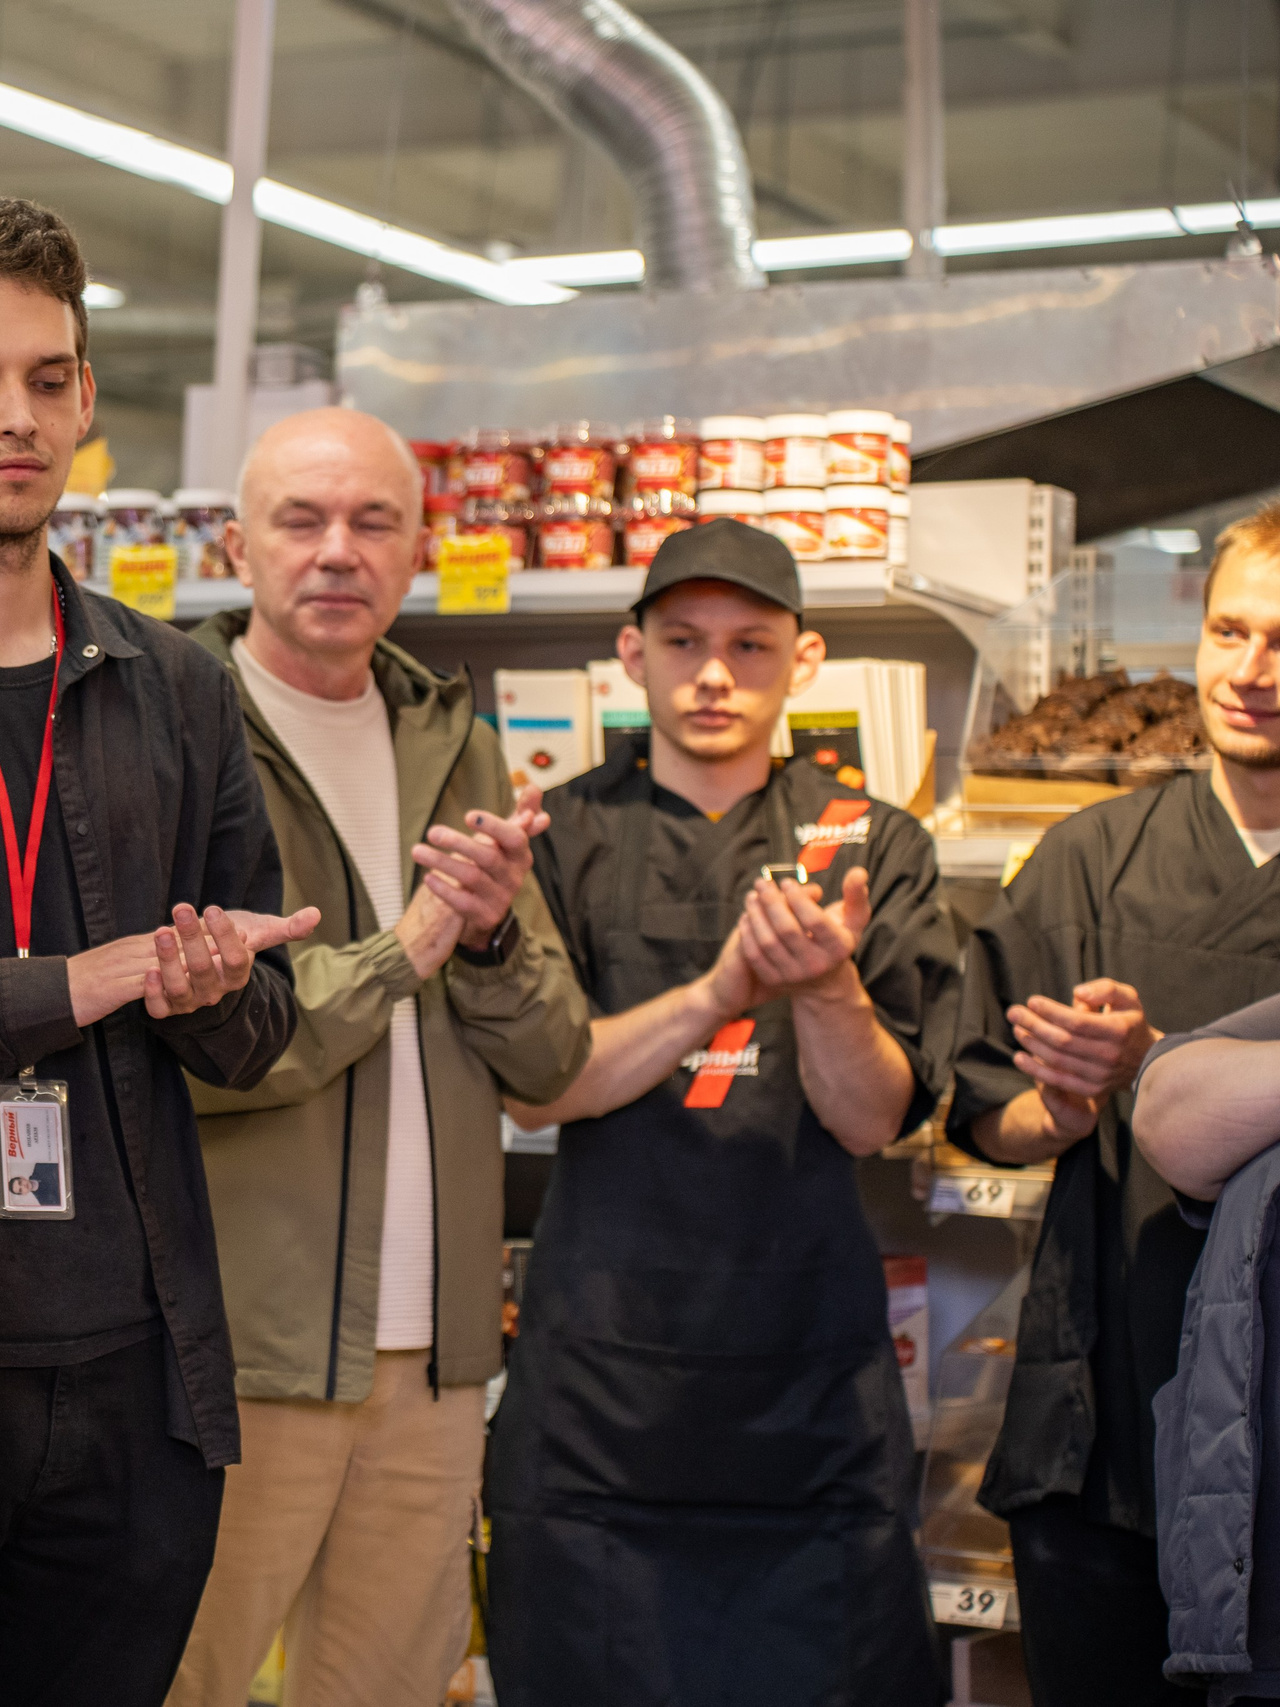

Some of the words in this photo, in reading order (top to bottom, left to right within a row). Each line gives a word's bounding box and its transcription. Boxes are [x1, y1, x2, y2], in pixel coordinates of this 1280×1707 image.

[4, 1111, 19, 1158] Верный
[966, 1183, 1004, 1206] 69
[957, 1586, 996, 1615] 39
